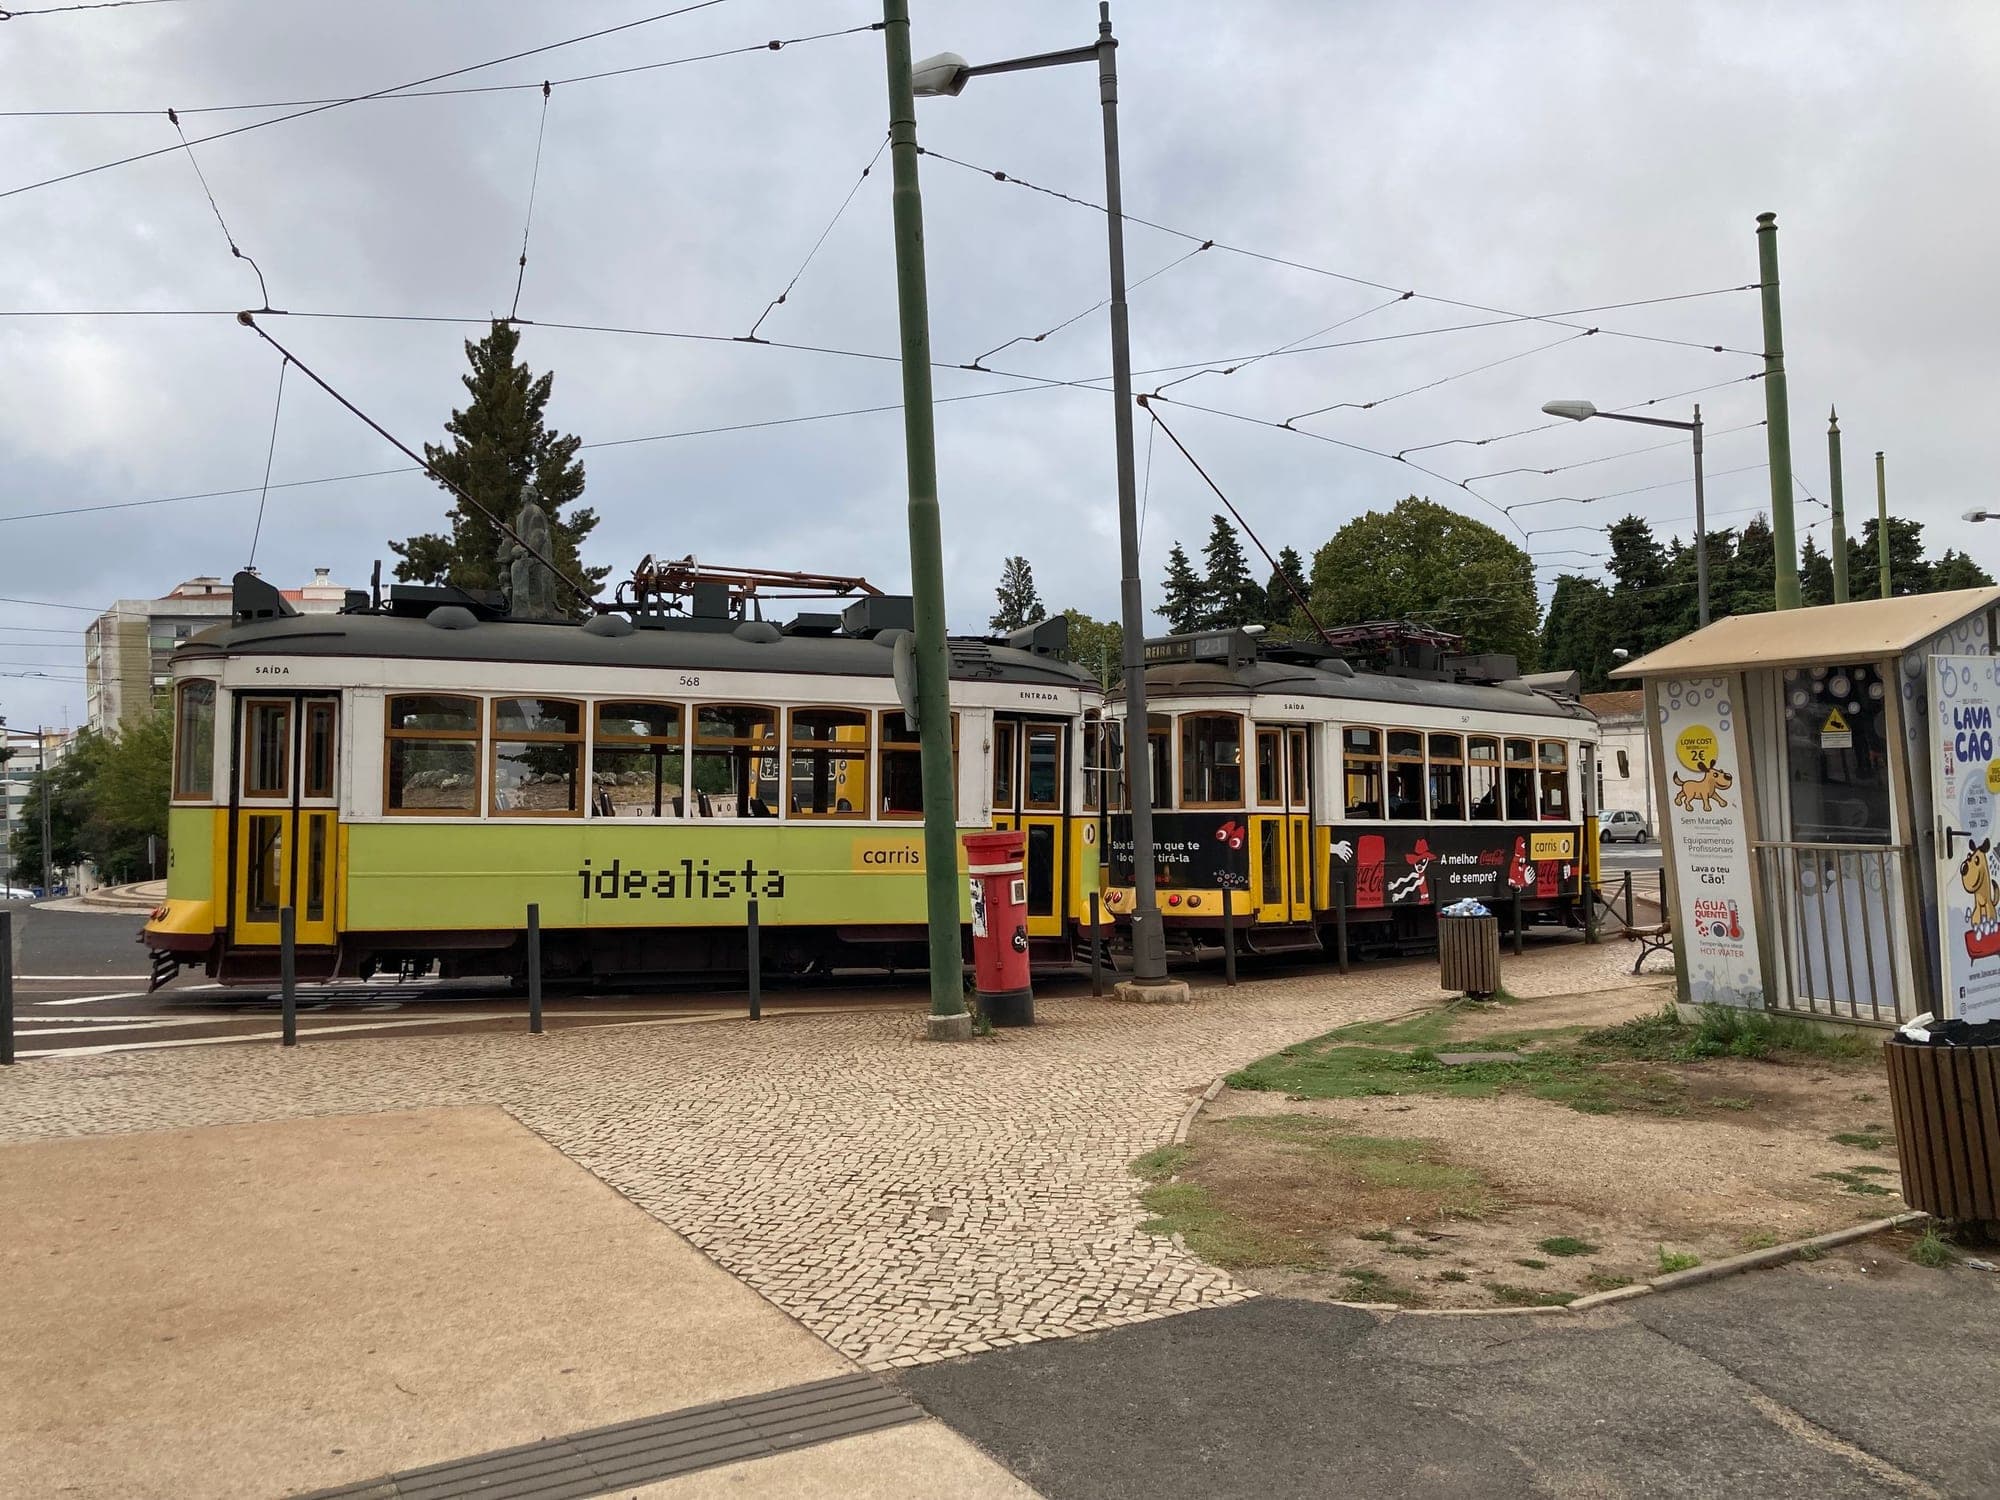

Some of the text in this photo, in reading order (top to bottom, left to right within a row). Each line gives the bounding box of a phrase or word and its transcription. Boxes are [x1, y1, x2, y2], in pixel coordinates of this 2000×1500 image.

[1145, 646, 1172, 659] REIRA
[255, 664, 290, 674] SAÍDA
[679, 675, 700, 687] 568
[1020, 691, 1058, 701] ENTRADA
[1284, 701, 1305, 710] SAÍDA
[1953, 706, 1992, 730] LAVA
[1680, 737, 1713, 746] LOW COST
[1690, 749, 1706, 761] 2€
[1680, 817, 1697, 825] Sem
[1534, 839, 1558, 852] carris
[1682, 836, 1735, 845] Equipamentos
[1126, 841, 1135, 850] tã
[1164, 842, 1185, 852] que
[1188, 841, 1200, 850] te
[1688, 845, 1734, 853] Profissionais
[863, 845, 920, 864] carris
[1158, 853, 1190, 863] tirá-la
[1440, 854, 1448, 865] A
[1448, 853, 1479, 865] melhor
[1691, 864, 1710, 873] Lava
[1717, 866, 1730, 874] teu
[579, 859, 785, 898] idealista
[1449, 870, 1498, 885] de sempre?
[1700, 873, 1726, 885] Cão!
[1694, 897, 1728, 911] ÁGUA
[1700, 947, 1745, 958] HOT WATER
